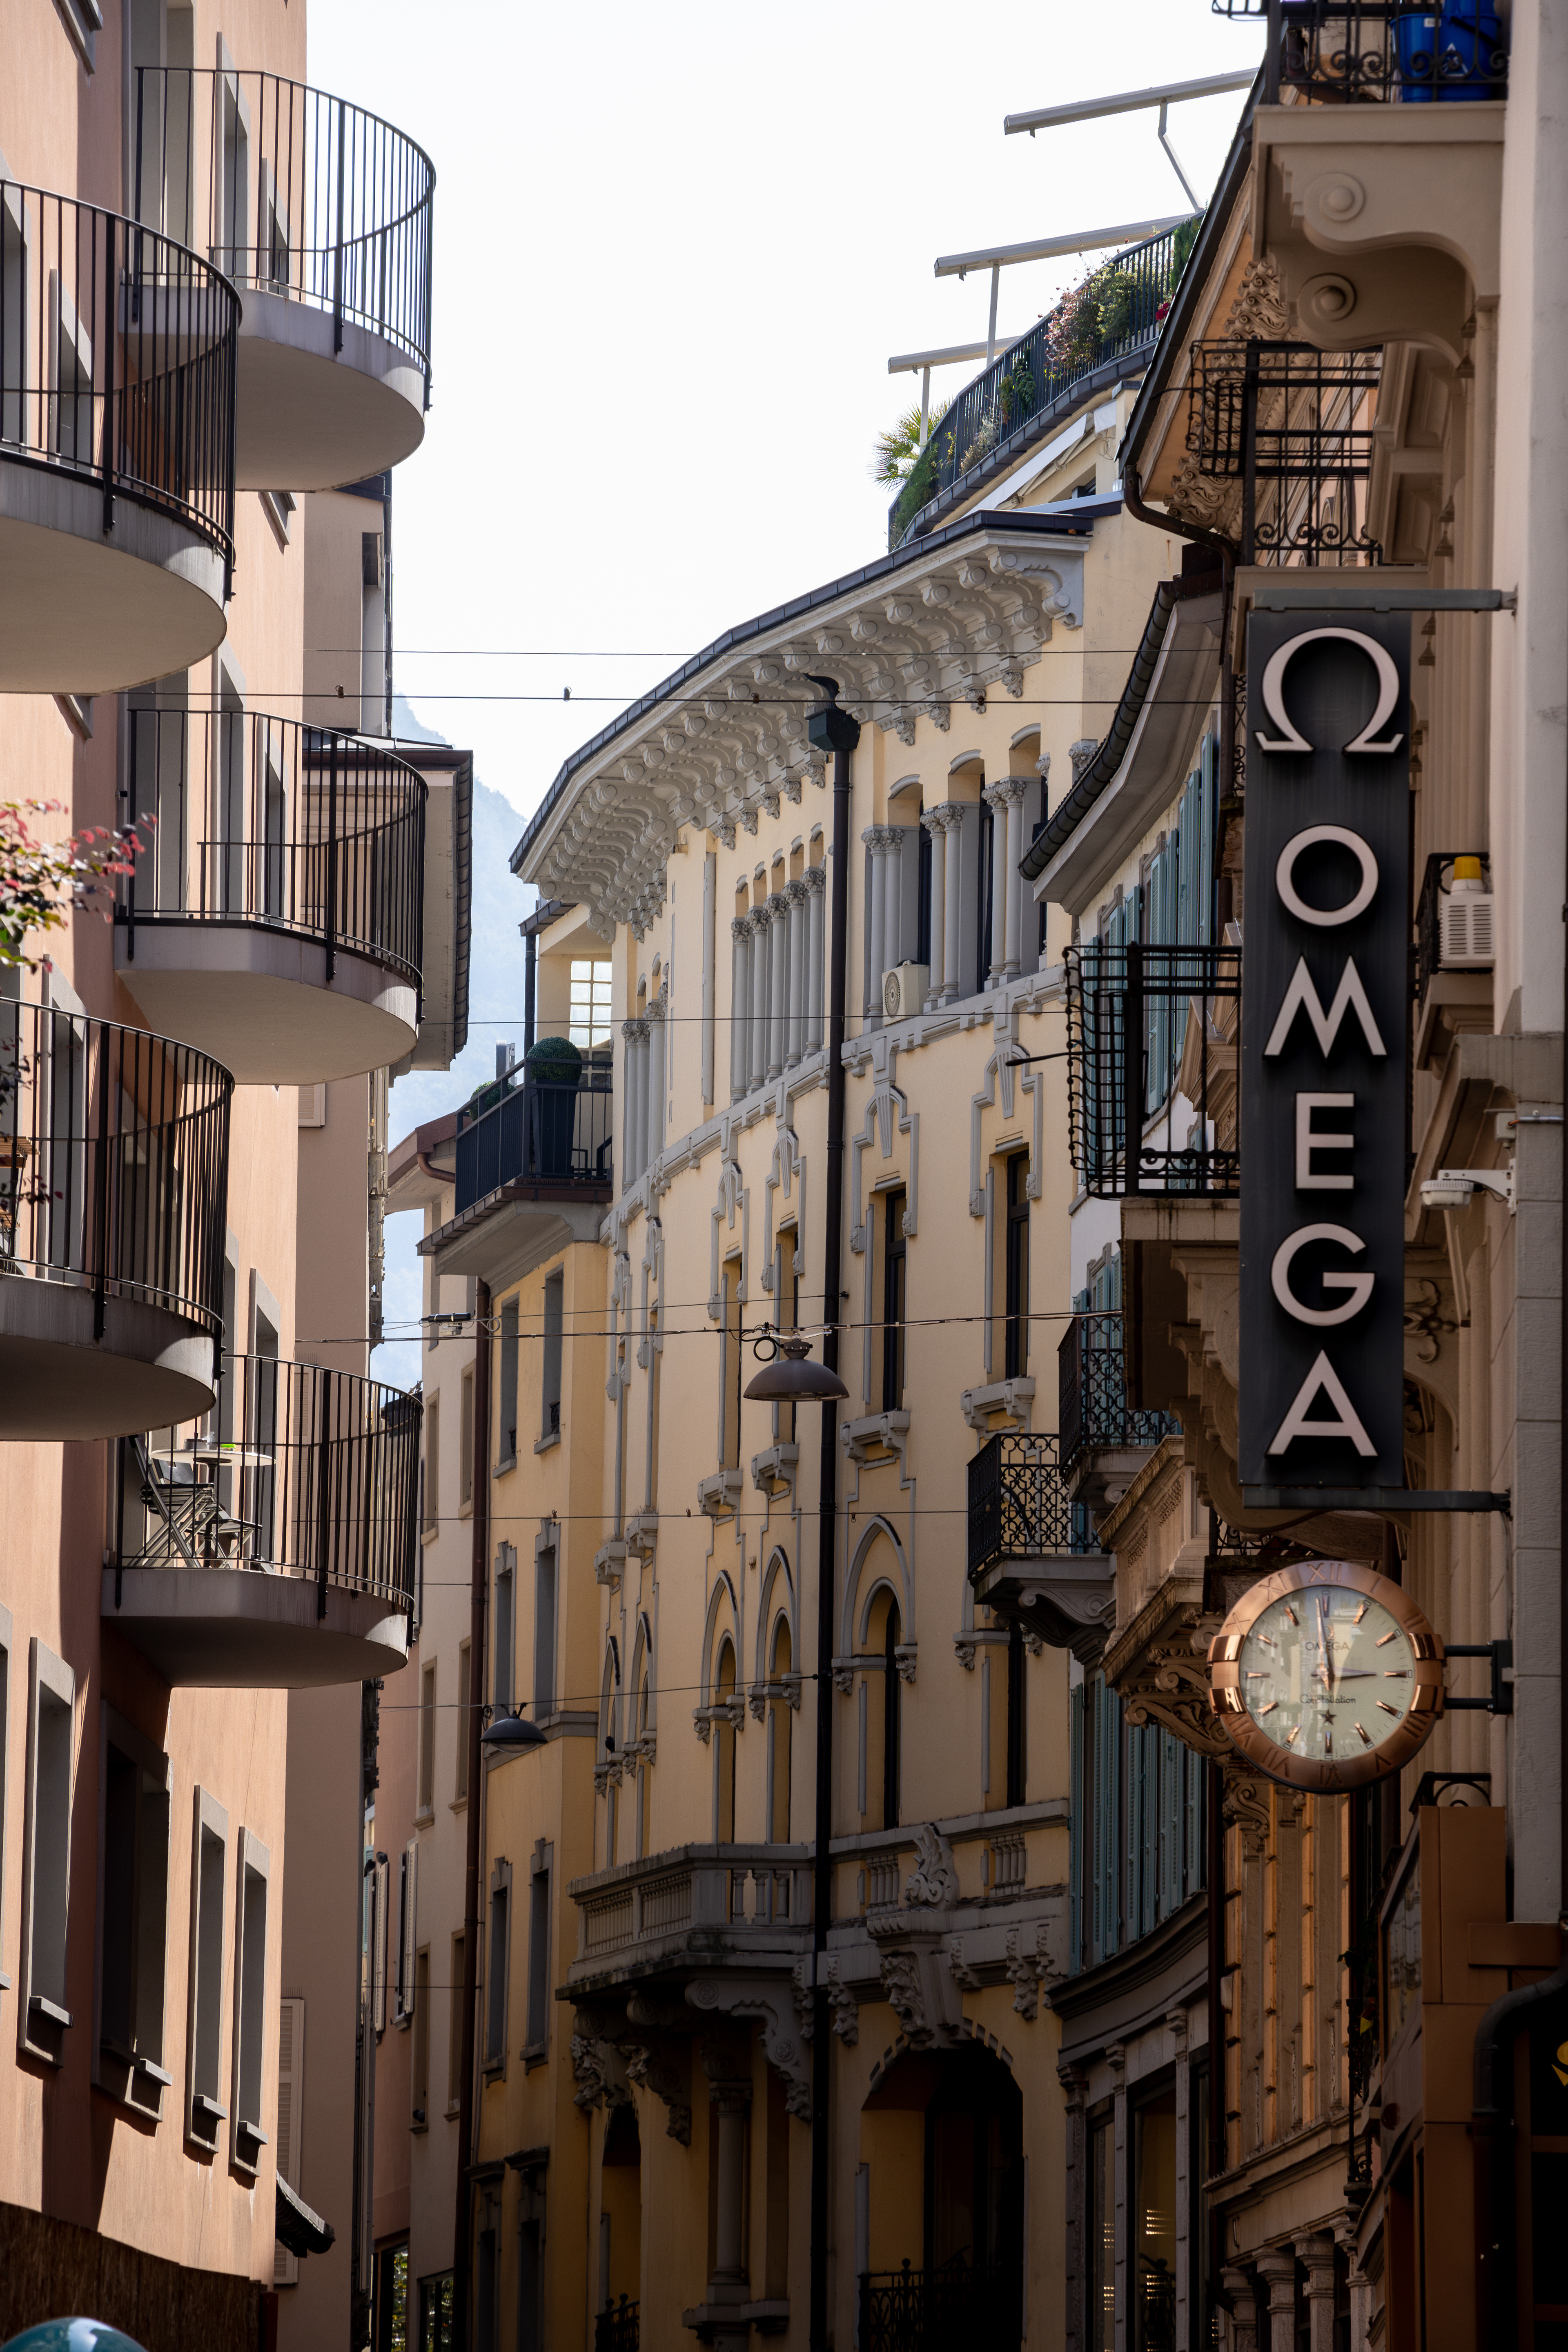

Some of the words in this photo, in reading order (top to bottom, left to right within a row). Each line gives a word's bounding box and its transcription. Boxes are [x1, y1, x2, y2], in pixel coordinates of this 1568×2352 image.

[1265, 825, 1386, 1456] OMEGA
[1307, 1562, 1343, 1583] XII
[1258, 1572, 1288, 1601] XI
[1225, 1612, 1252, 1634] X
[1404, 1613, 1427, 1631] II
[1261, 1746, 1290, 1777] VII
[1374, 1752, 1394, 1773] V
[1319, 1764, 1344, 1787] VI
